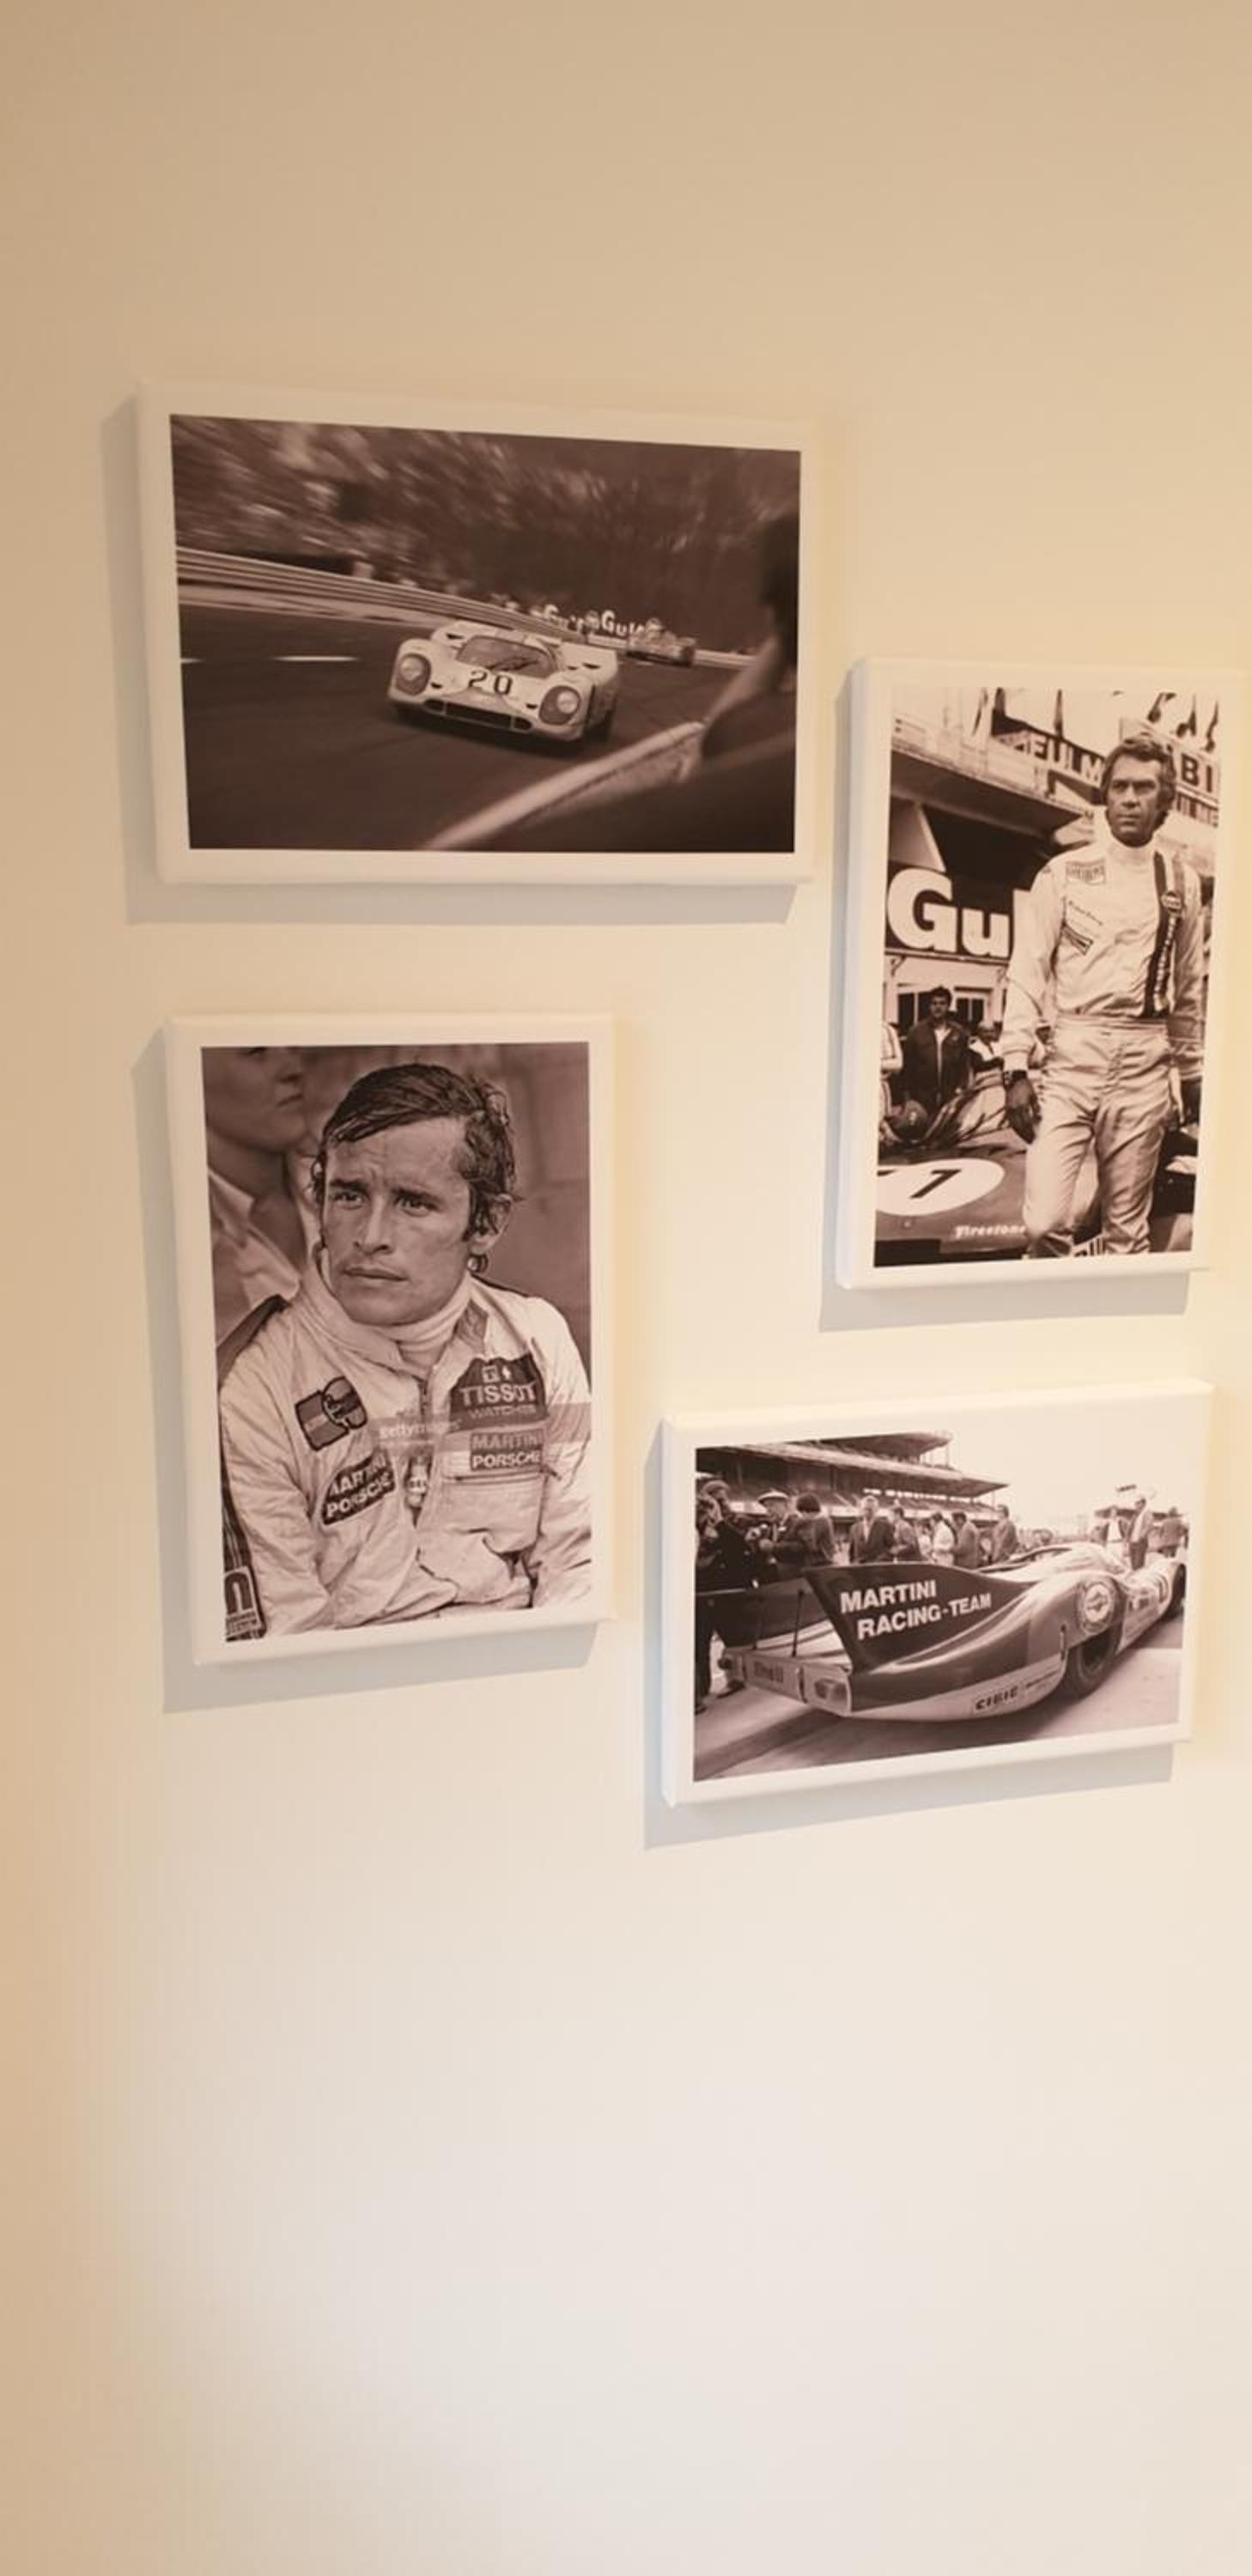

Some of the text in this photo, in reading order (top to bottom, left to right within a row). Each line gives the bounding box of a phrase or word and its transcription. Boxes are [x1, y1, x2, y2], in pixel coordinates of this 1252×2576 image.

[468, 670, 513, 695] 20
[459, 1381, 537, 1406] TISSOT
[472, 1451, 541, 1471] PORSCHE
[840, 1580, 937, 1614] MARTINI
[857, 1593, 992, 1641] RACING-TEAM
